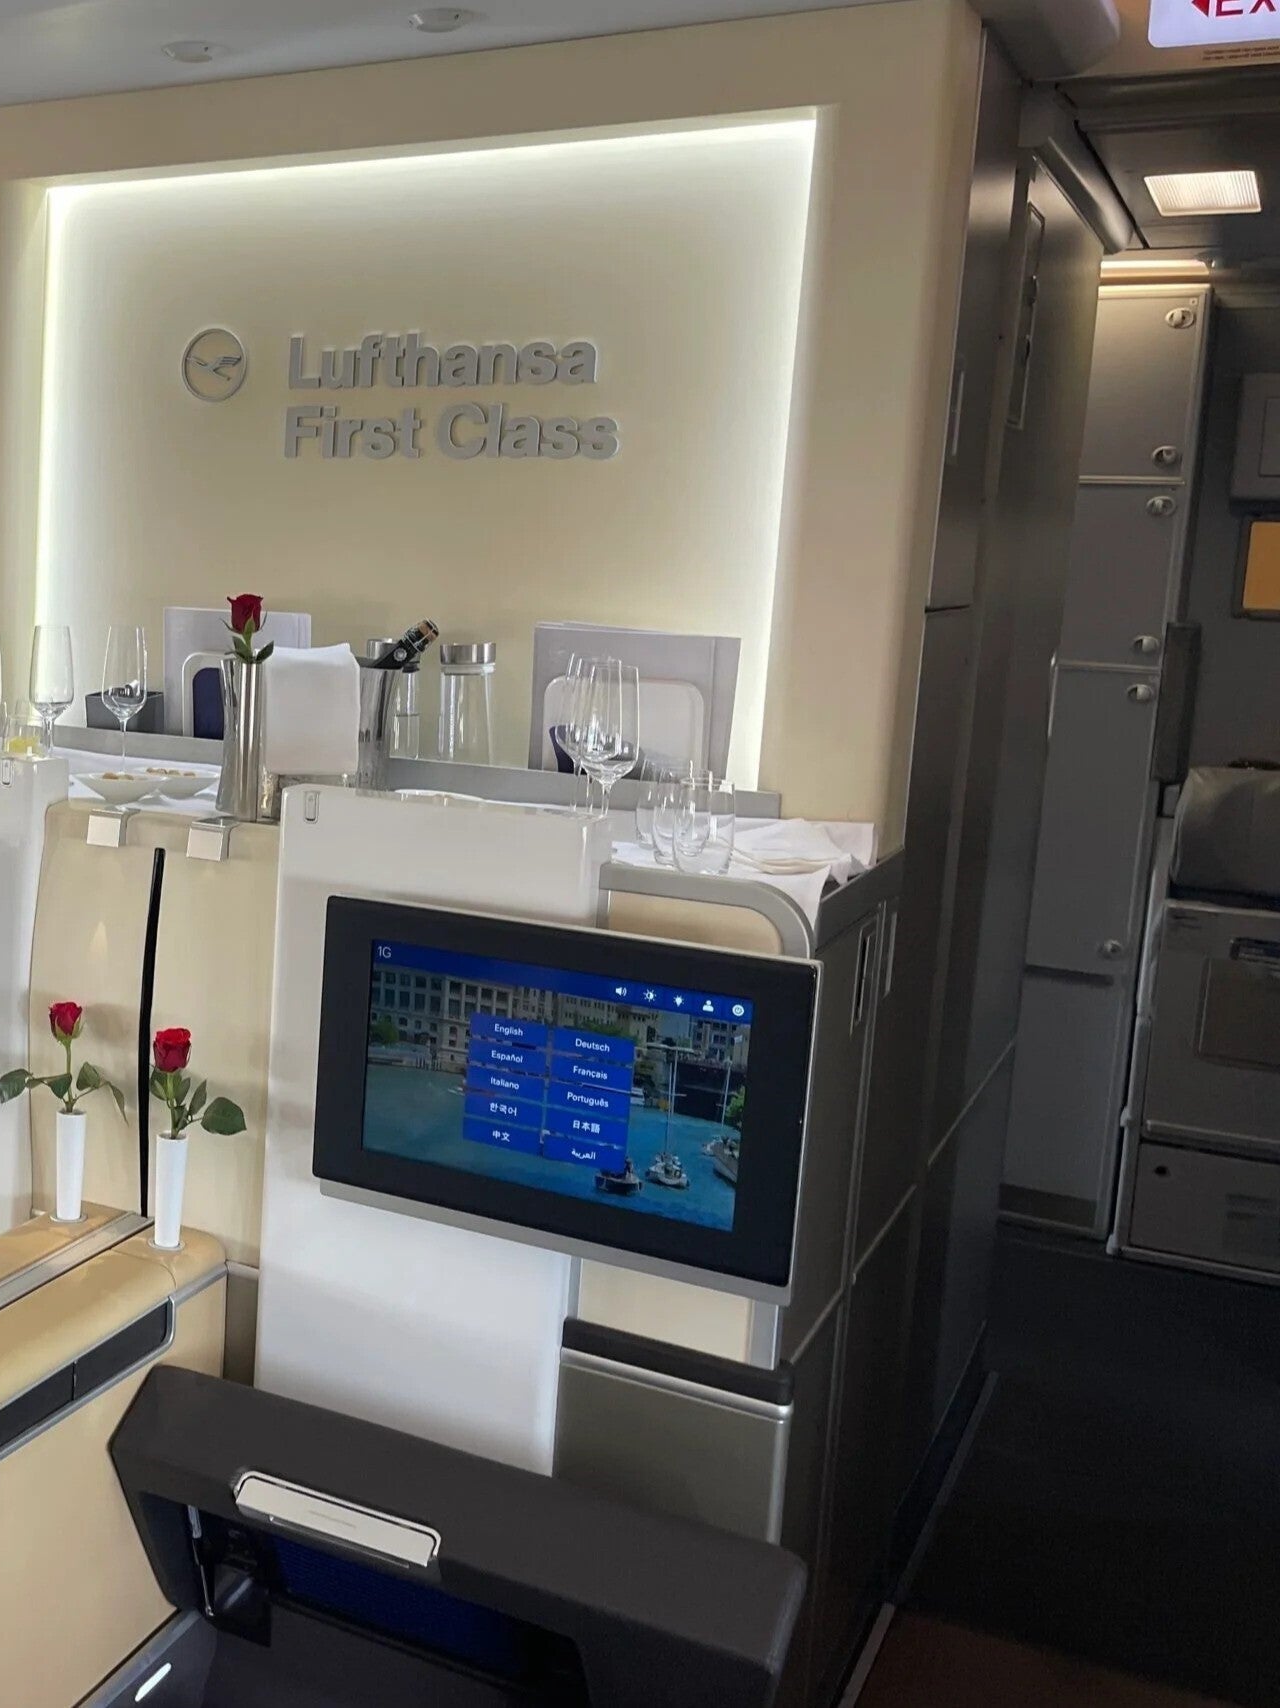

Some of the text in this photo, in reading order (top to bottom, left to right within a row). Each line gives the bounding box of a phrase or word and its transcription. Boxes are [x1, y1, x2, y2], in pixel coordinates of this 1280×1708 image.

[287, 329, 598, 390] Lufthansa
[283, 401, 620, 460] First Class
[377, 945, 392, 959] 1G
[494, 1023, 524, 1037] English
[575, 1037, 610, 1053] Deutsch
[491, 1050, 524, 1064] Español
[573, 1065, 608, 1080] Français
[490, 1076, 520, 1090] Italiano
[567, 1091, 609, 1108] Português
[489, 1102, 517, 1117] 한국어
[573, 1120, 600, 1134] 日本語
[492, 1130, 510, 1142] 中文
[571, 1148, 597, 1160] العربية
